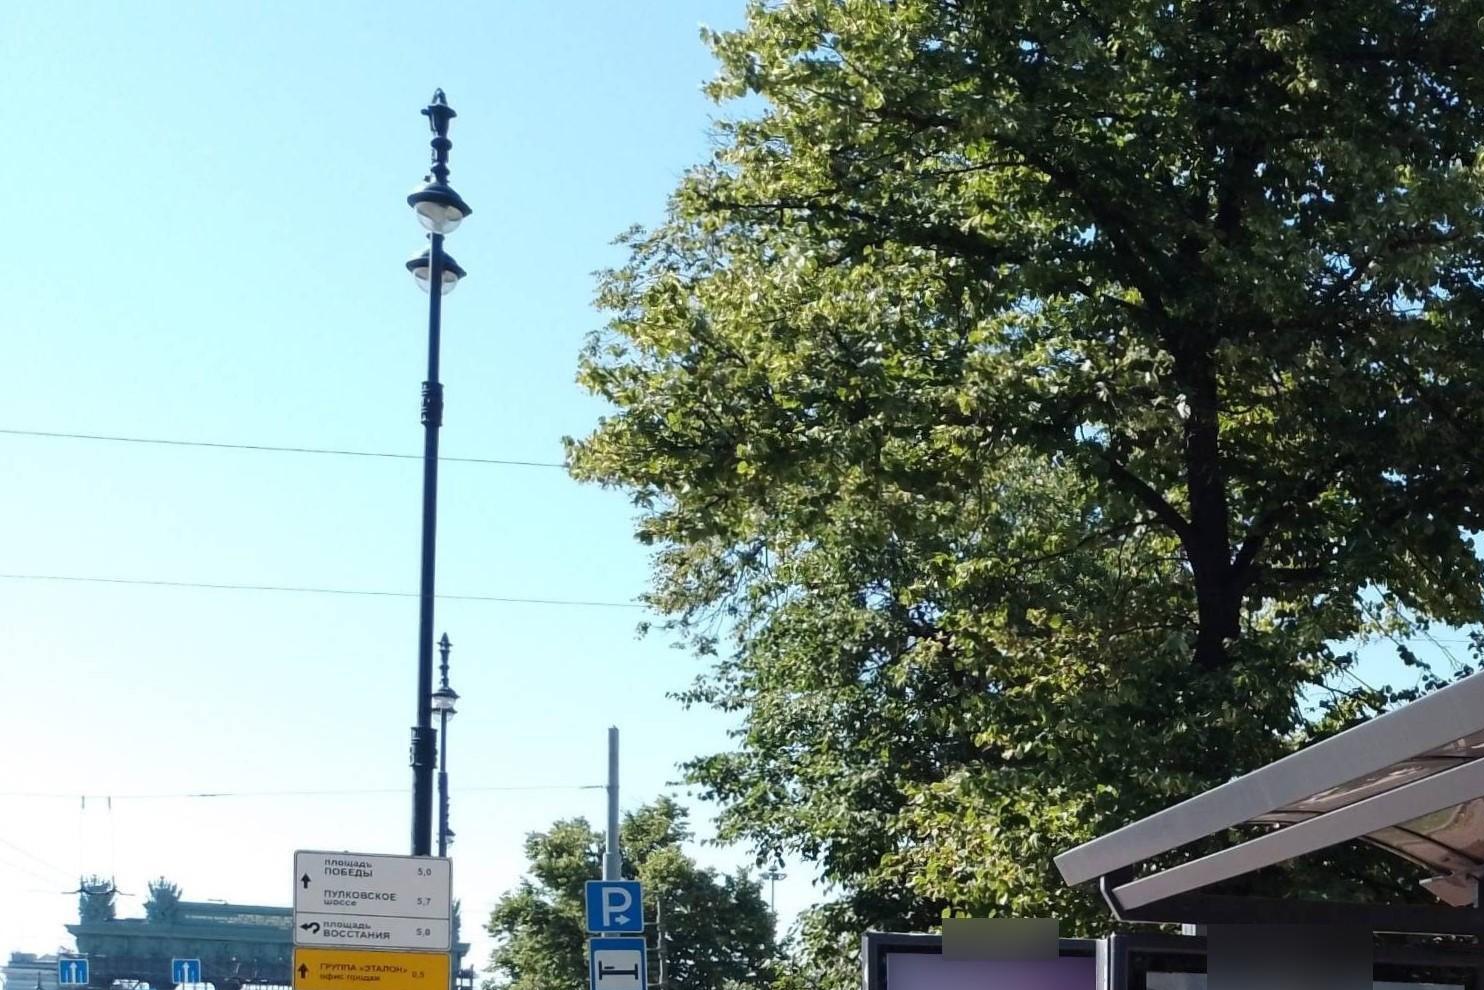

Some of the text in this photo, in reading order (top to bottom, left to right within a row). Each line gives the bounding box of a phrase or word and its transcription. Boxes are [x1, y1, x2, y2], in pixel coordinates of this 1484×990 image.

[324, 859, 373, 868] площадь
[324, 867, 373, 878] ПОБЕДЫ
[418, 868, 432, 876] 5,0
[324, 890, 397, 901] ПУЛКОВСКОЕ
[417, 897, 431, 906] 5,7
[602, 887, 632, 927] P
[323, 921, 371, 930] площадь
[323, 929, 391, 940] ВОССТАНИЯ
[320, 962, 356, 972] ГРУППА
